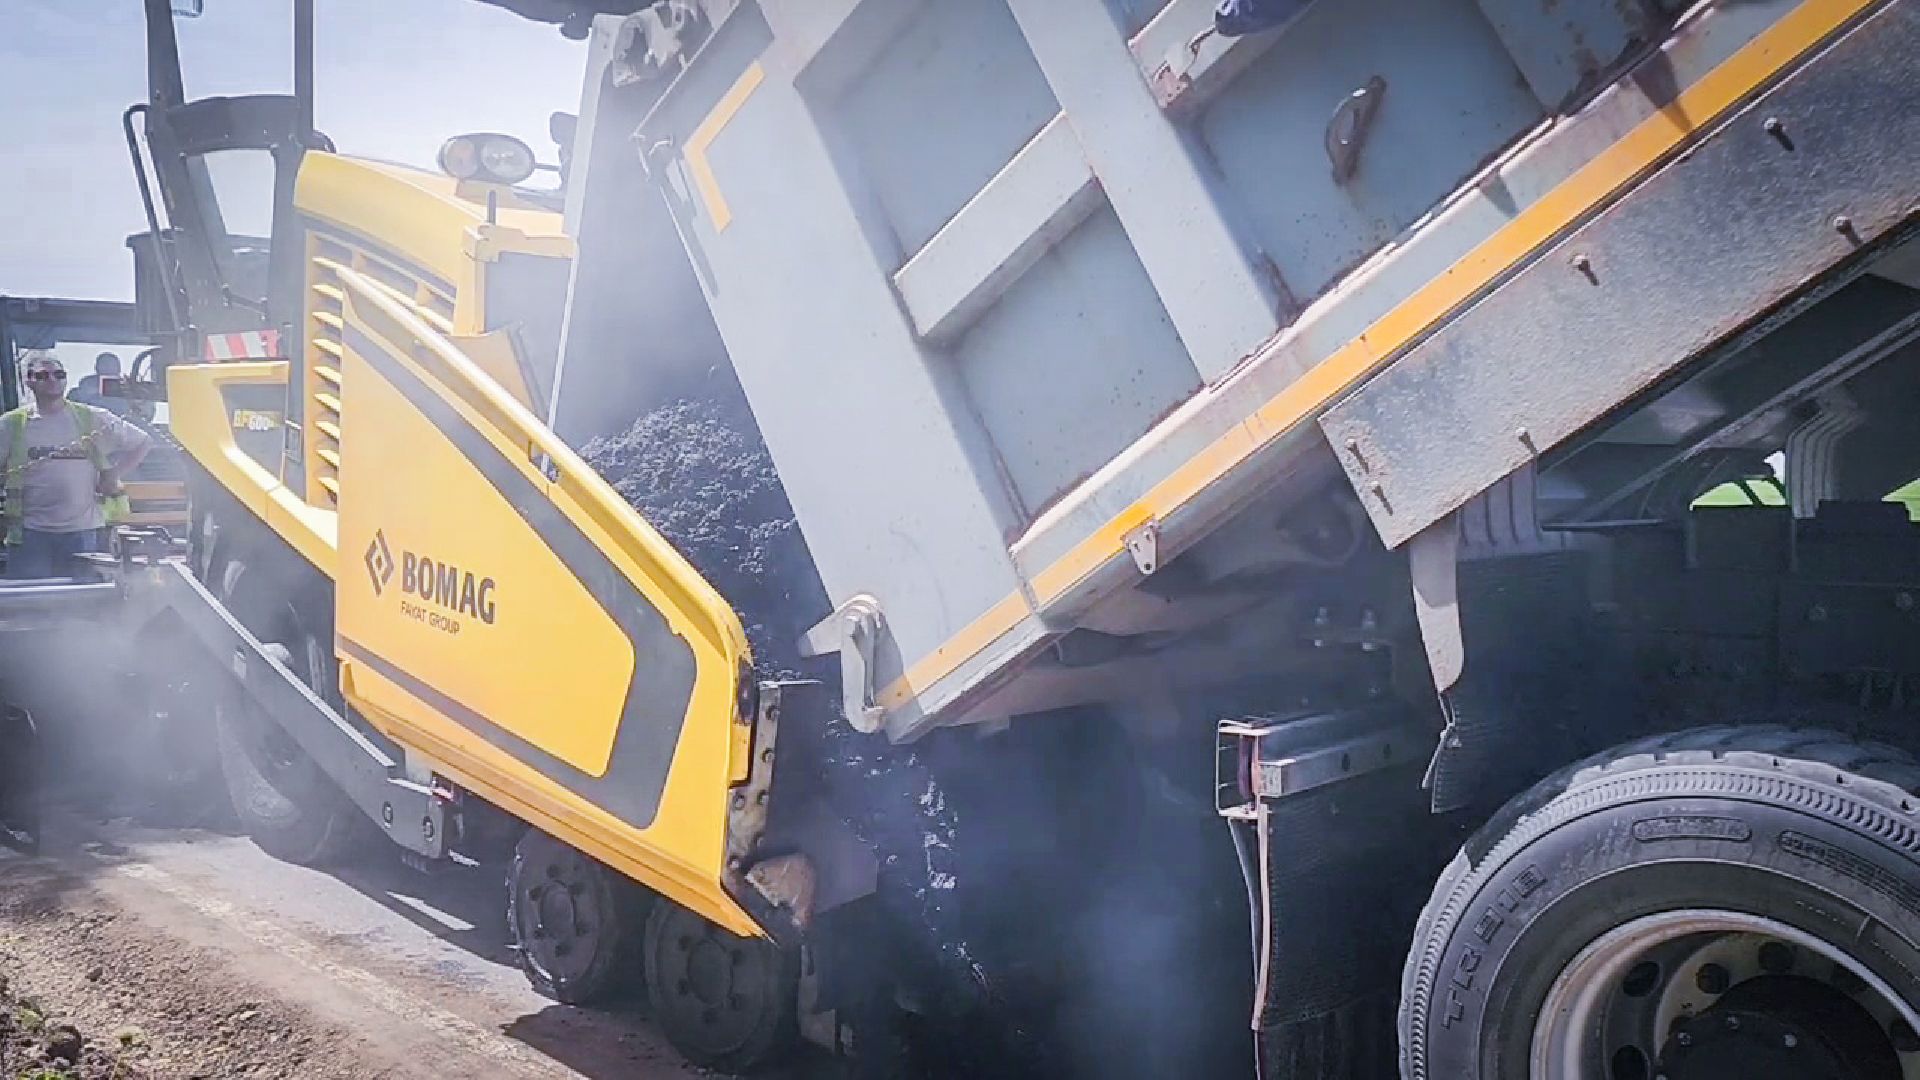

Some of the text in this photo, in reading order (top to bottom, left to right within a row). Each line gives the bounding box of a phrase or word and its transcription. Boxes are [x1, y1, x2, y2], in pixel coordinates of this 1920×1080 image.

[402, 550, 495, 624] BOMAG
[401, 600, 460, 635] FAYAT GROUP
